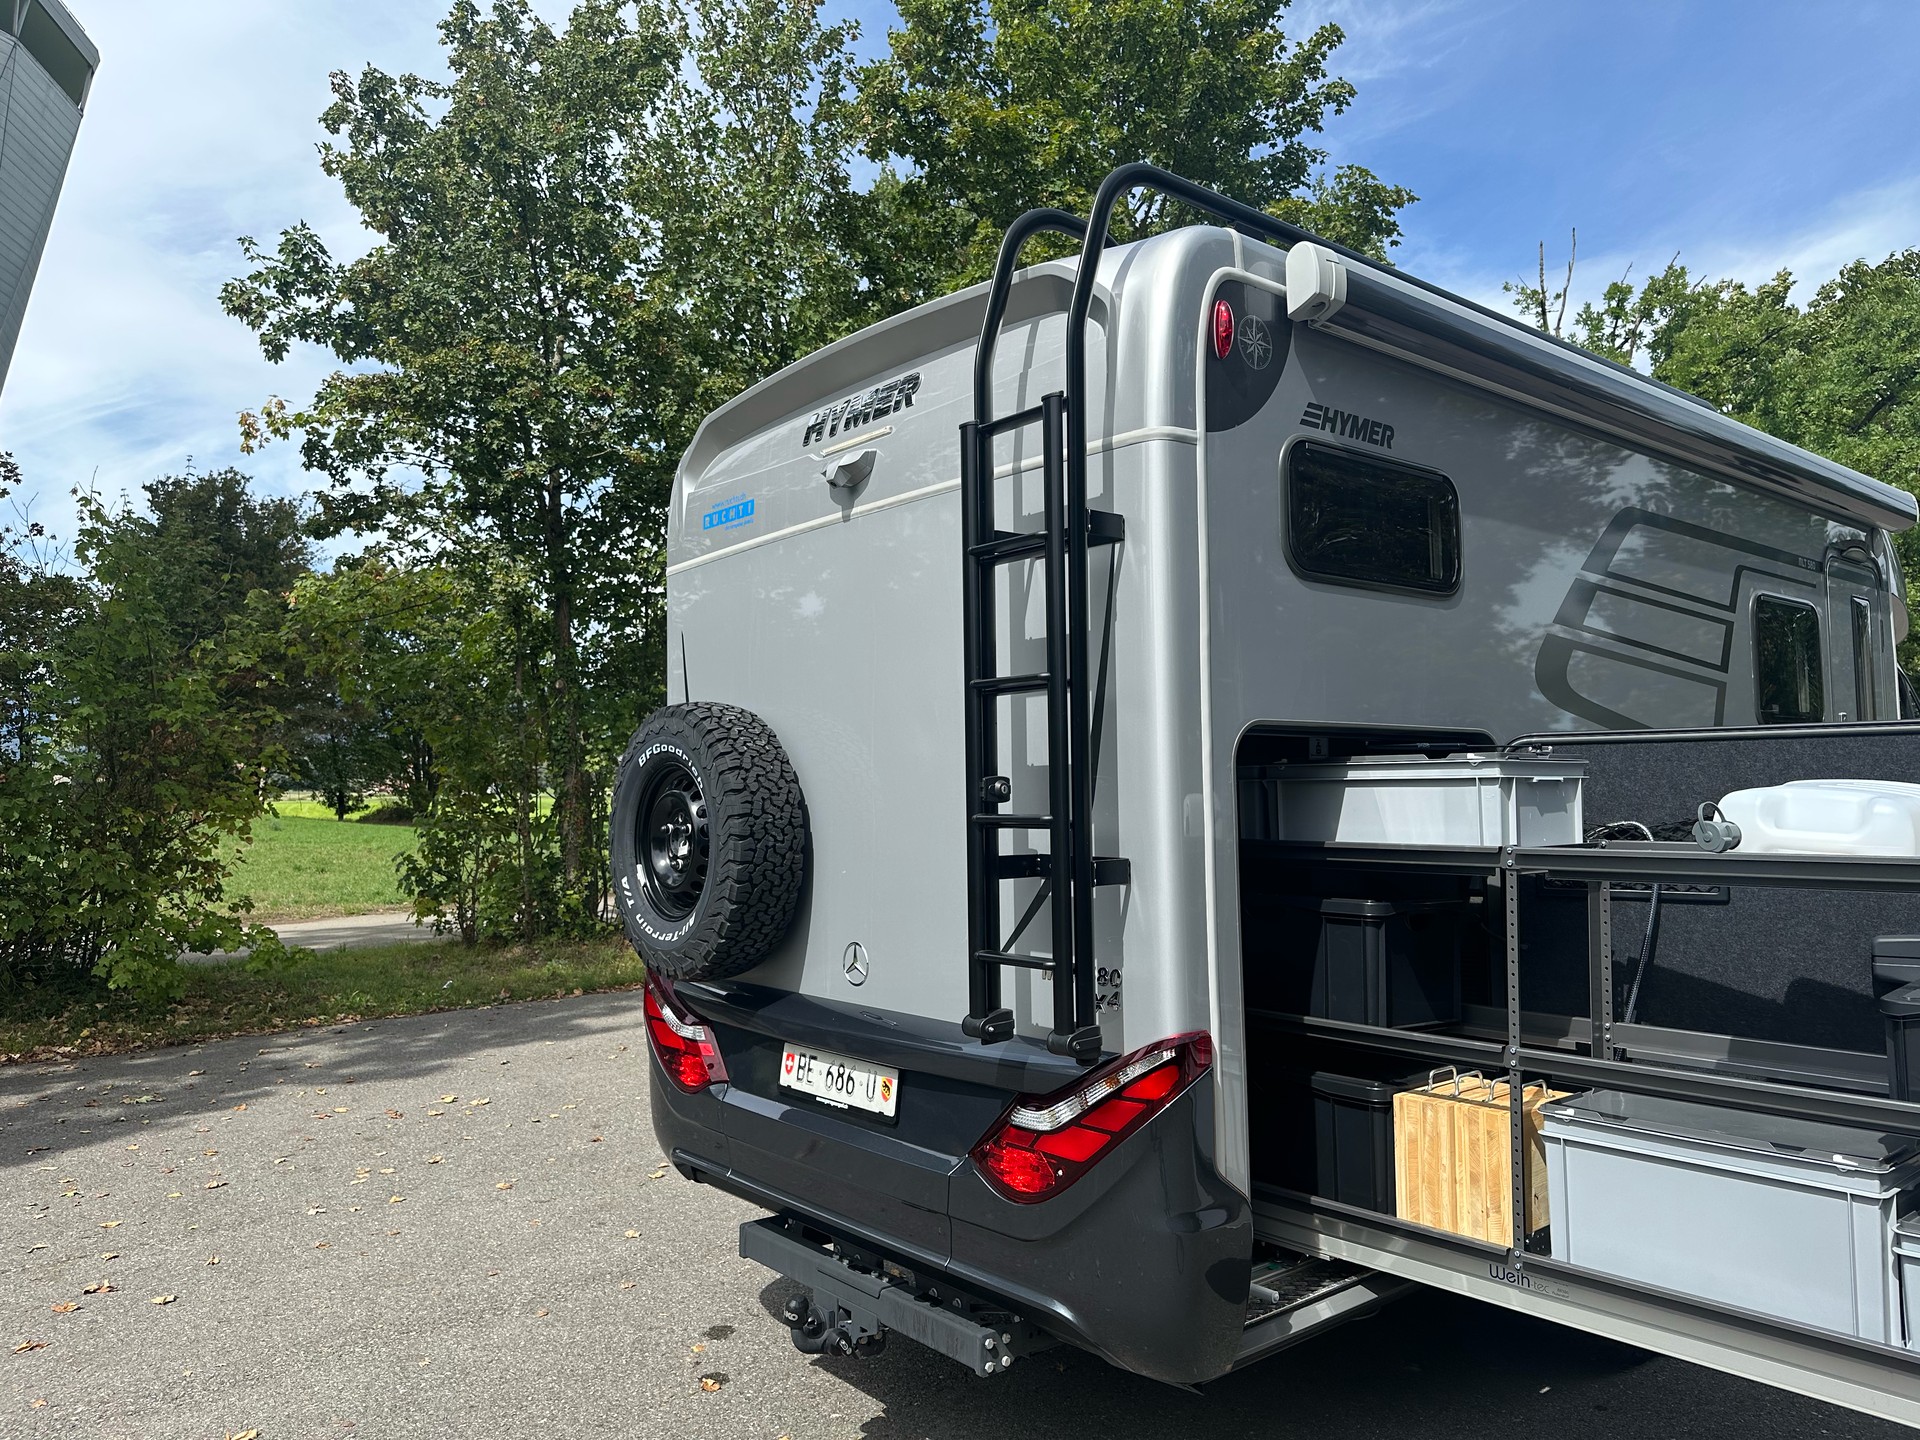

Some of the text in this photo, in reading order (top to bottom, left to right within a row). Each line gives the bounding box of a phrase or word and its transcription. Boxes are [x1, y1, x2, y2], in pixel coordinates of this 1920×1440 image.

[802, 372, 922, 447] HYMER
[1319, 406, 1395, 449] HYMER
[704, 501, 753, 528] RUCHTI
[796, 1052, 878, 1102] BE 686 U
